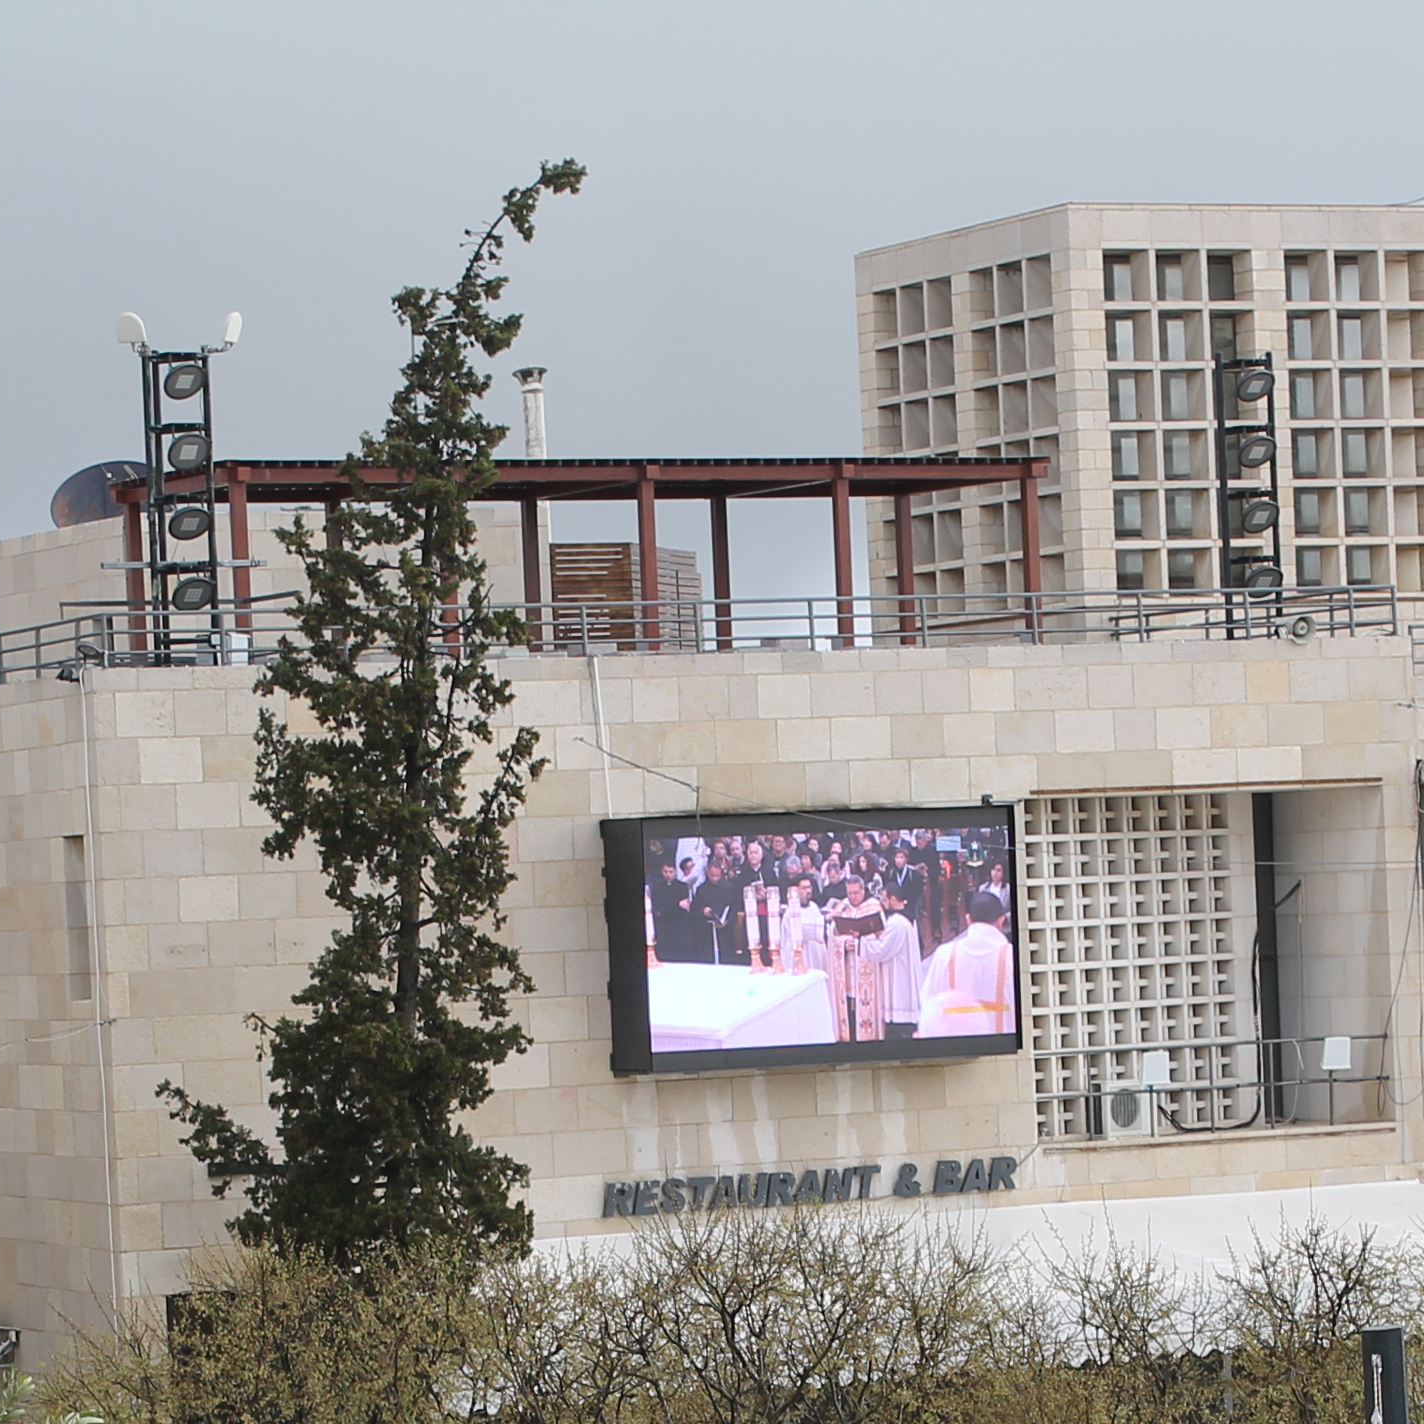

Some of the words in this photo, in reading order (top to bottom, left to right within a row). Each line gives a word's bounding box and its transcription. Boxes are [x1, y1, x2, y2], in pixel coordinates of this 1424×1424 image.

[603, 1164, 881, 1217] RESTAURANT
[894, 1163, 921, 1198] &
[933, 1156, 1018, 1195] BAR
